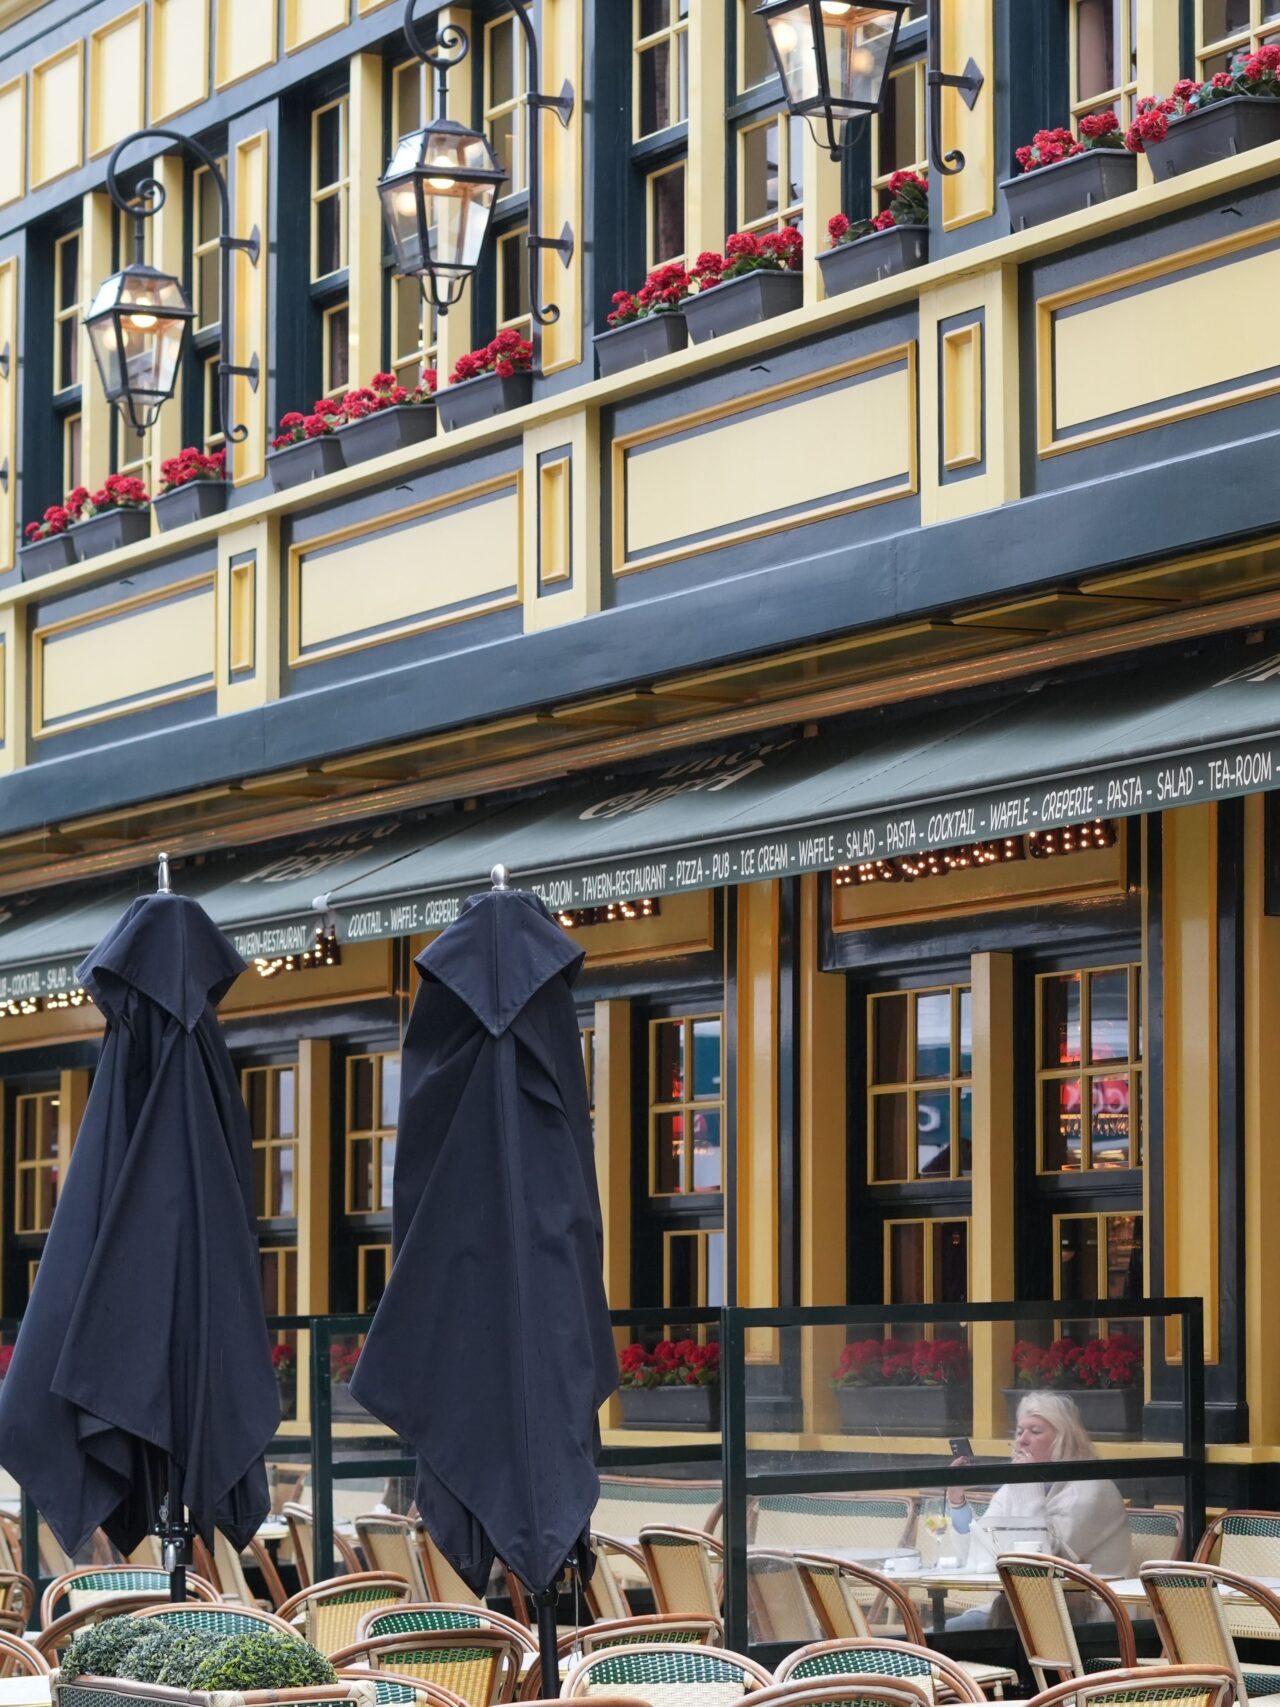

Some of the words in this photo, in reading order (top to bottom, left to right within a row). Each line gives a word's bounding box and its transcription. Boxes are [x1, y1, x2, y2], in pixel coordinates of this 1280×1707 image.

[348, 911, 382, 938] COCKTAIL
[390, 904, 417, 931] WAFFLE
[425, 898, 460, 926] CREPERIE
[582, 864, 667, 902] TAVERN-RESTAURANT
[676, 857, 703, 887] PIZZA
[712, 851, 730, 880] PUB
[740, 849, 755, 876] ICE
[757, 843, 788, 873] CREAM
[798, 835, 834, 866] WAFFLE
[846, 828, 876, 859] SALAD
[886, 819, 916, 852] PASTA
[927, 808, 976, 843] COCKTAIL
[990, 797, 1030, 831] WAFFLE
[1041, 785, 1095, 822] CREPERIE
[1106, 776, 1142, 811] PASTA
[1157, 766, 1194, 801] SALAD
[1208, 751, 1272, 791] TEA-ROOM
[47, 967, 67, 990] SALAD
[234, 925, 307, 956] TAVERN-RESTAURANT
